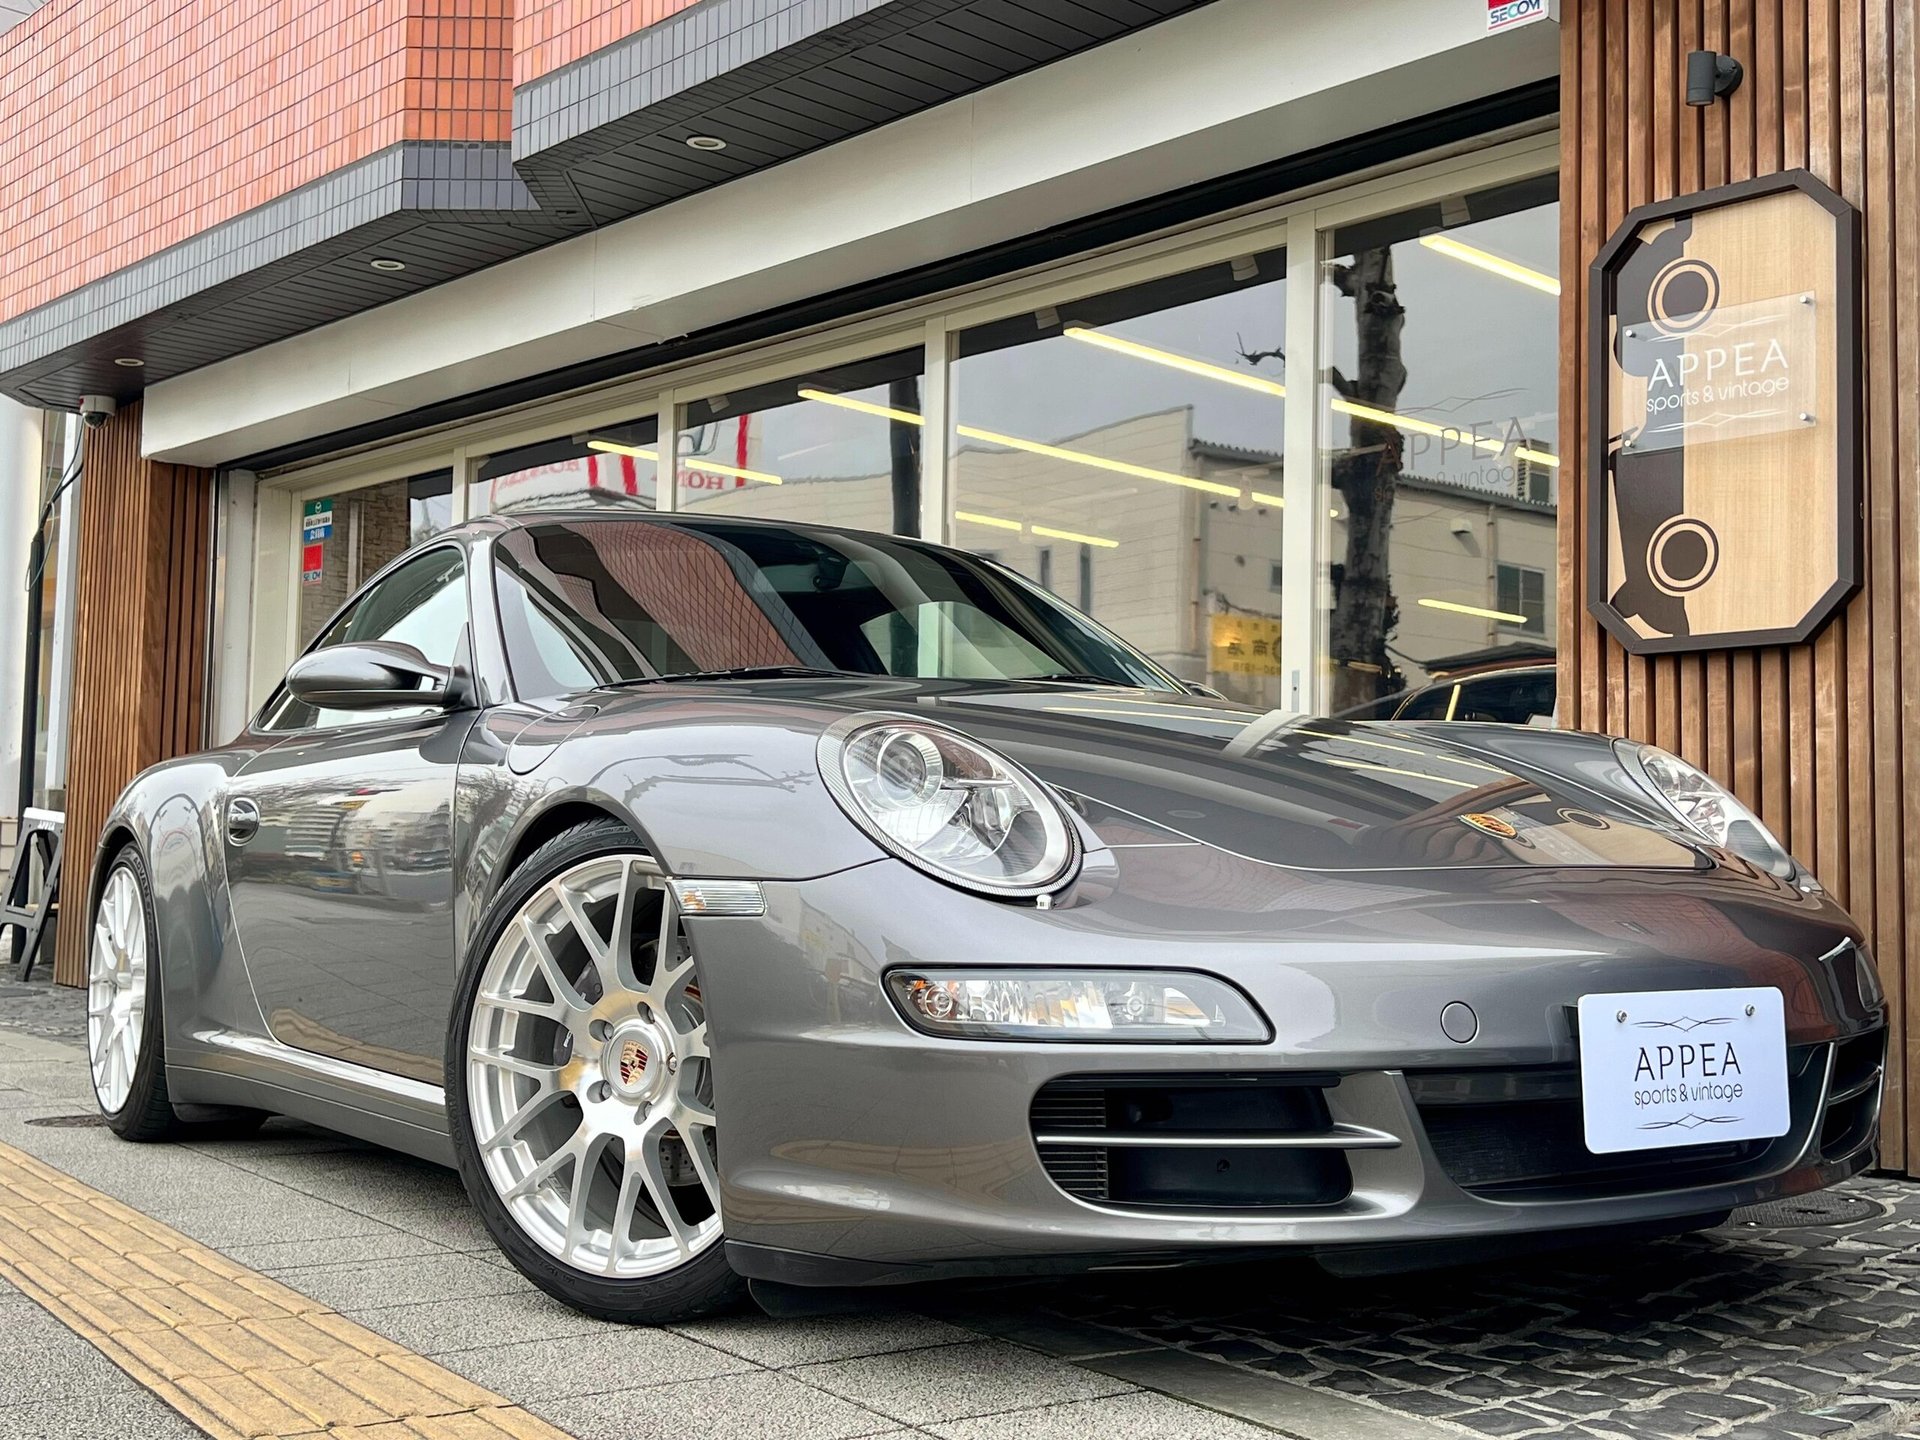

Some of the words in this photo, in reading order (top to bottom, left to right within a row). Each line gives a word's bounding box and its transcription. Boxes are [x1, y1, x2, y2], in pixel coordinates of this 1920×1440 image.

[1490, 0, 1540, 25] SECOM
[1647, 338, 1789, 391] APPEA
[1646, 388, 1700, 415] sports
[1702, 385, 1714, 403] &
[1718, 376, 1789, 401] vintage
[1376, 416, 1531, 476] APPEA
[1453, 465, 1517, 487] vintag
[1634, 1042, 1741, 1082] APPEA
[1634, 1084, 1677, 1109] sports
[1679, 1083, 1688, 1102] &
[1691, 1081, 1743, 1102] vintage
